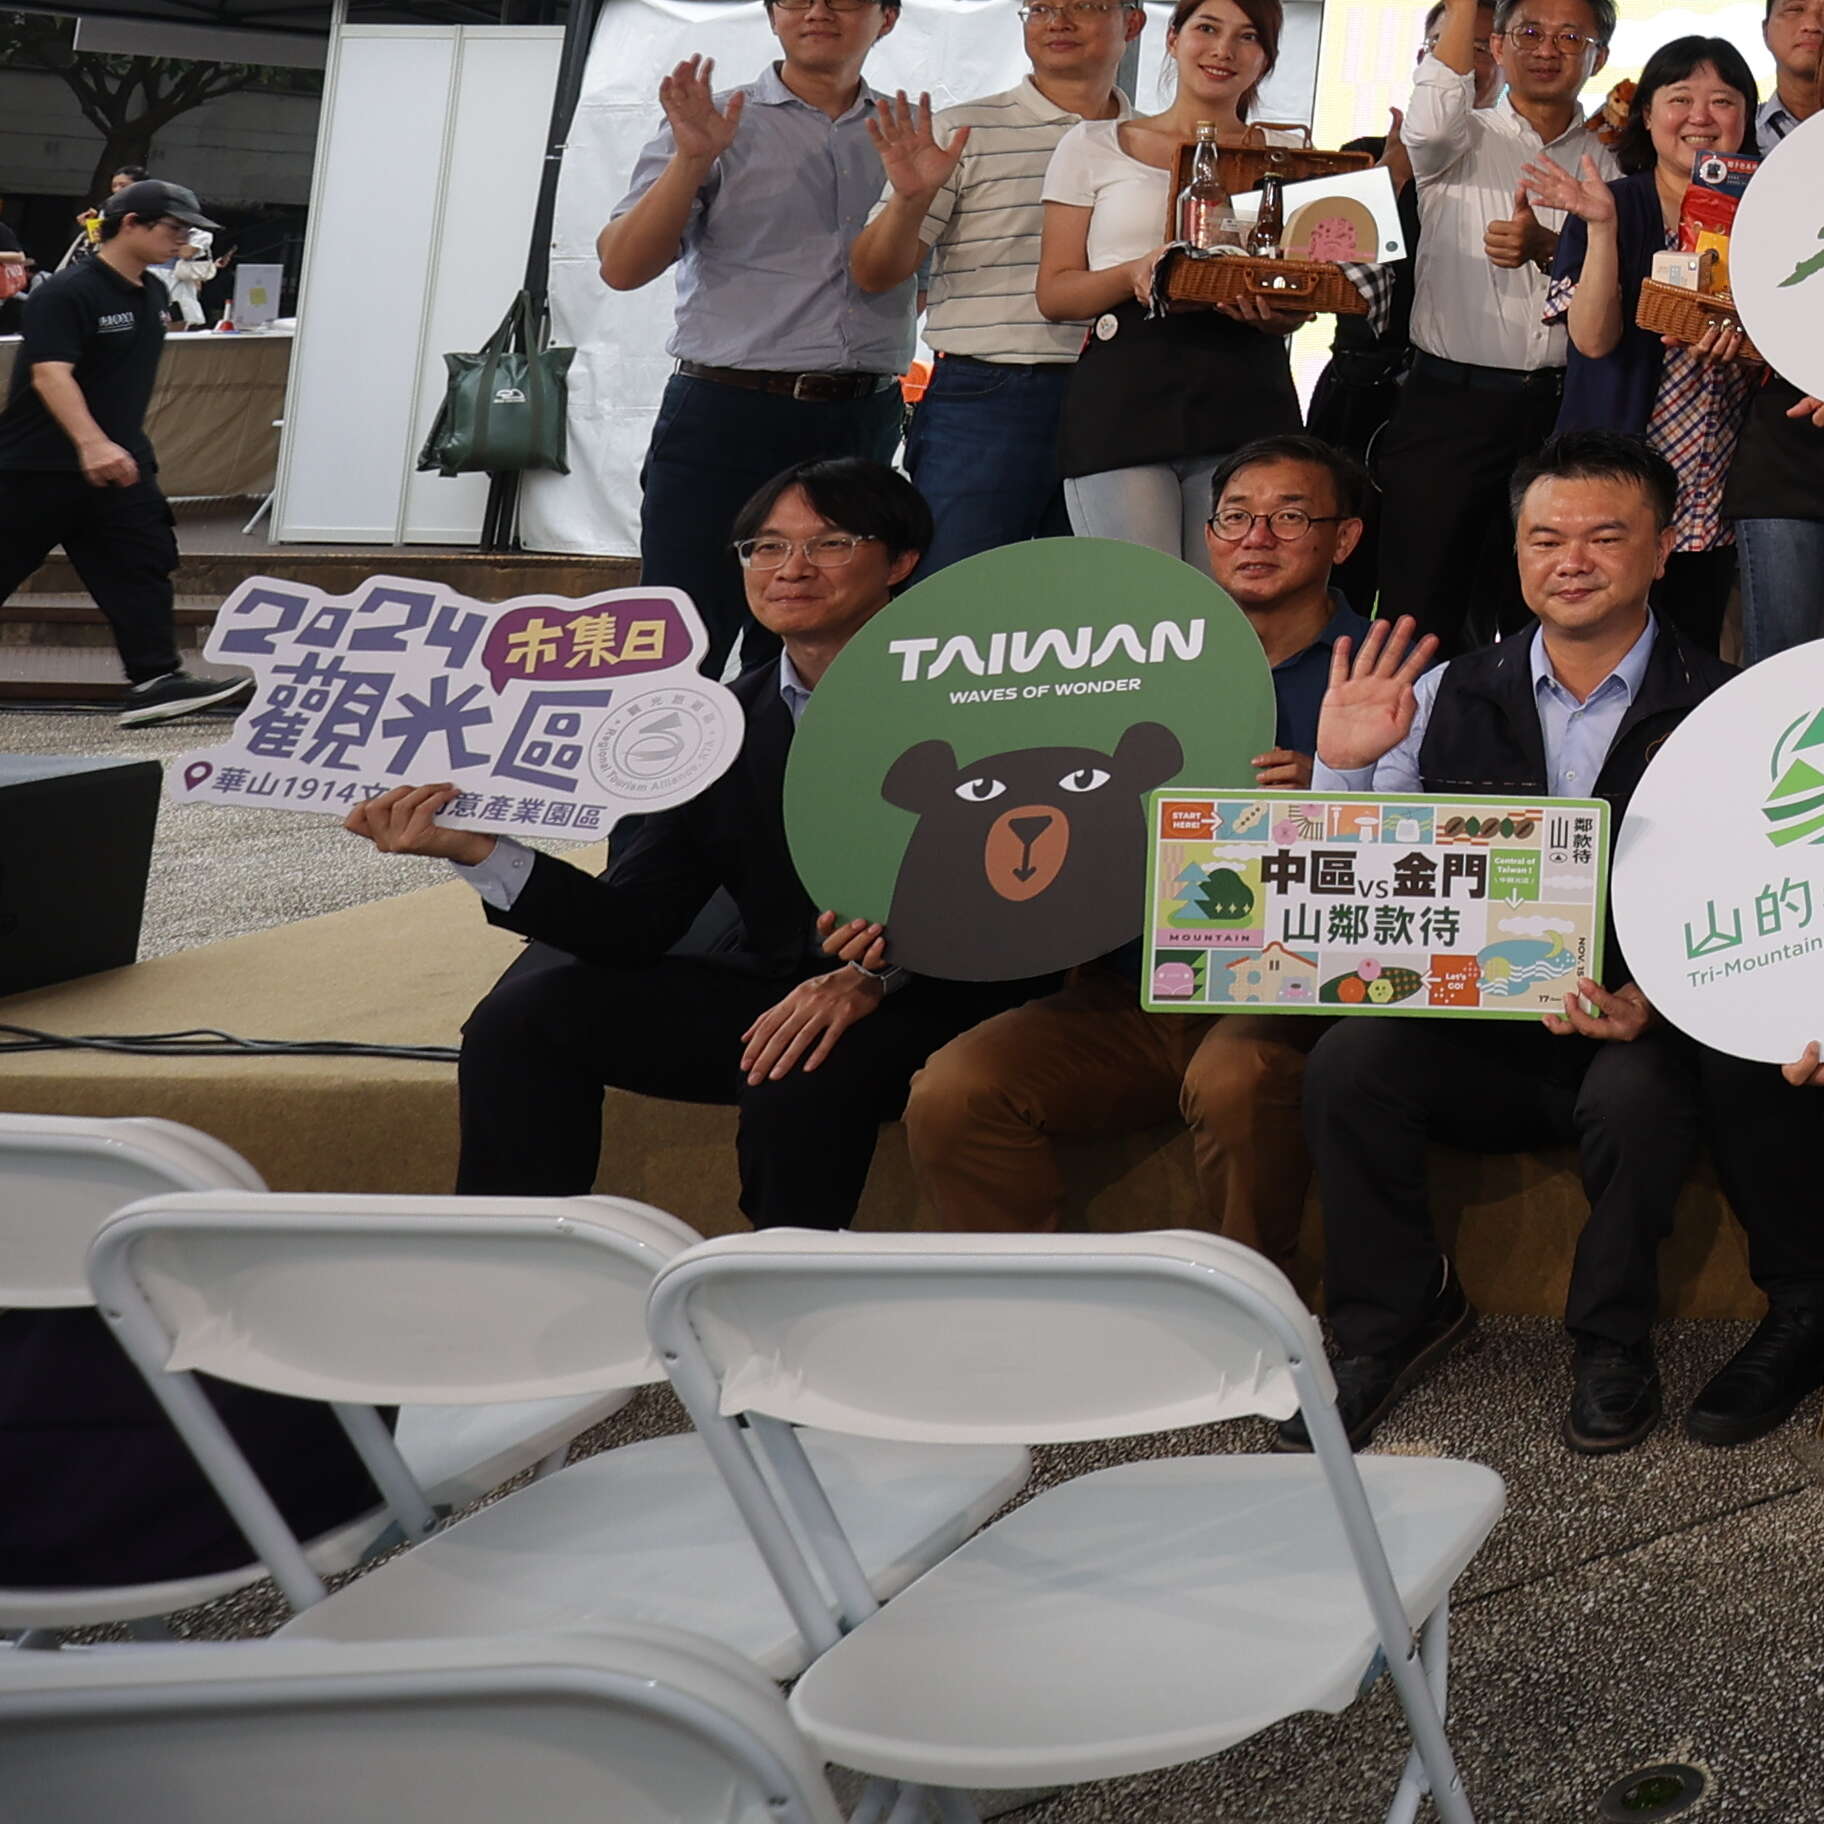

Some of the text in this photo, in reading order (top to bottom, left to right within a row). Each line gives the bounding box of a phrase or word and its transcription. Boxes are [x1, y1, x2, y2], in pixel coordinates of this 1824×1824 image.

[219, 586, 489, 670] 2024
[505, 612, 667, 675] 市集日
[888, 618, 1206, 682] TAIWAN
[949, 677, 1142, 705] WAVES OF WONDER
[246, 652, 614, 794] 觀光區
[212, 766, 609, 830] 華山1914文意產業園區
[1172, 812, 1202, 821] START
[1172, 821, 1201, 830] HERE!
[1168, 933, 1251, 943] MOUNTAIN
[1283, 902, 1461, 948] 山鄰款待
[1445, 972, 1467, 981] Let's
[1447, 981, 1464, 990] GO!
[1538, 994, 1550, 1003] 17
